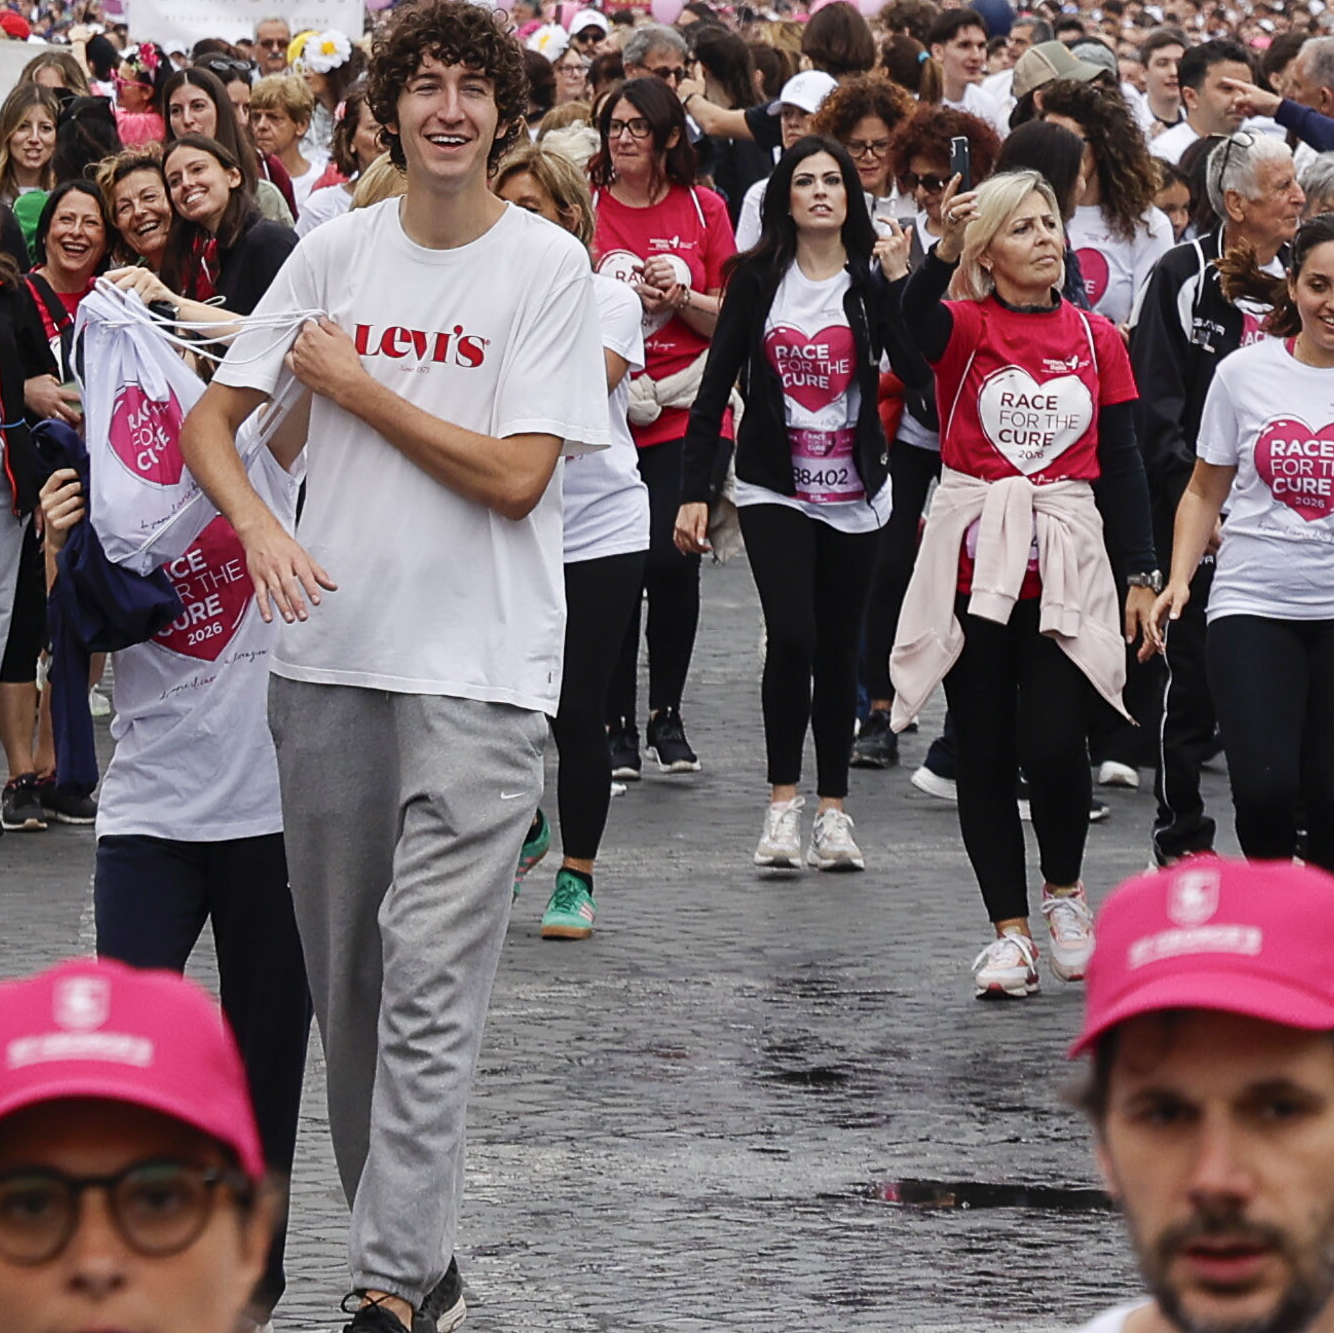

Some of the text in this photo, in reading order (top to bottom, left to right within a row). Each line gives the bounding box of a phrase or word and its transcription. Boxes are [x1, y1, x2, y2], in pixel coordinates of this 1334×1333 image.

[775, 343, 830, 360] RACE
[777, 358, 850, 375] FOR THE
[781, 373, 830, 389] CURE
[1000, 391, 1058, 411] RACE
[998, 410, 1081, 430] FOR THE
[998, 429, 1056, 447] CURE
[1270, 458, 1314, 476] FOR
[1272, 477, 1332, 497] CURE
[1295, 496, 1325, 508] 2026
[194, 558, 244, 593] THE
[188, 621, 223, 646] 2026
